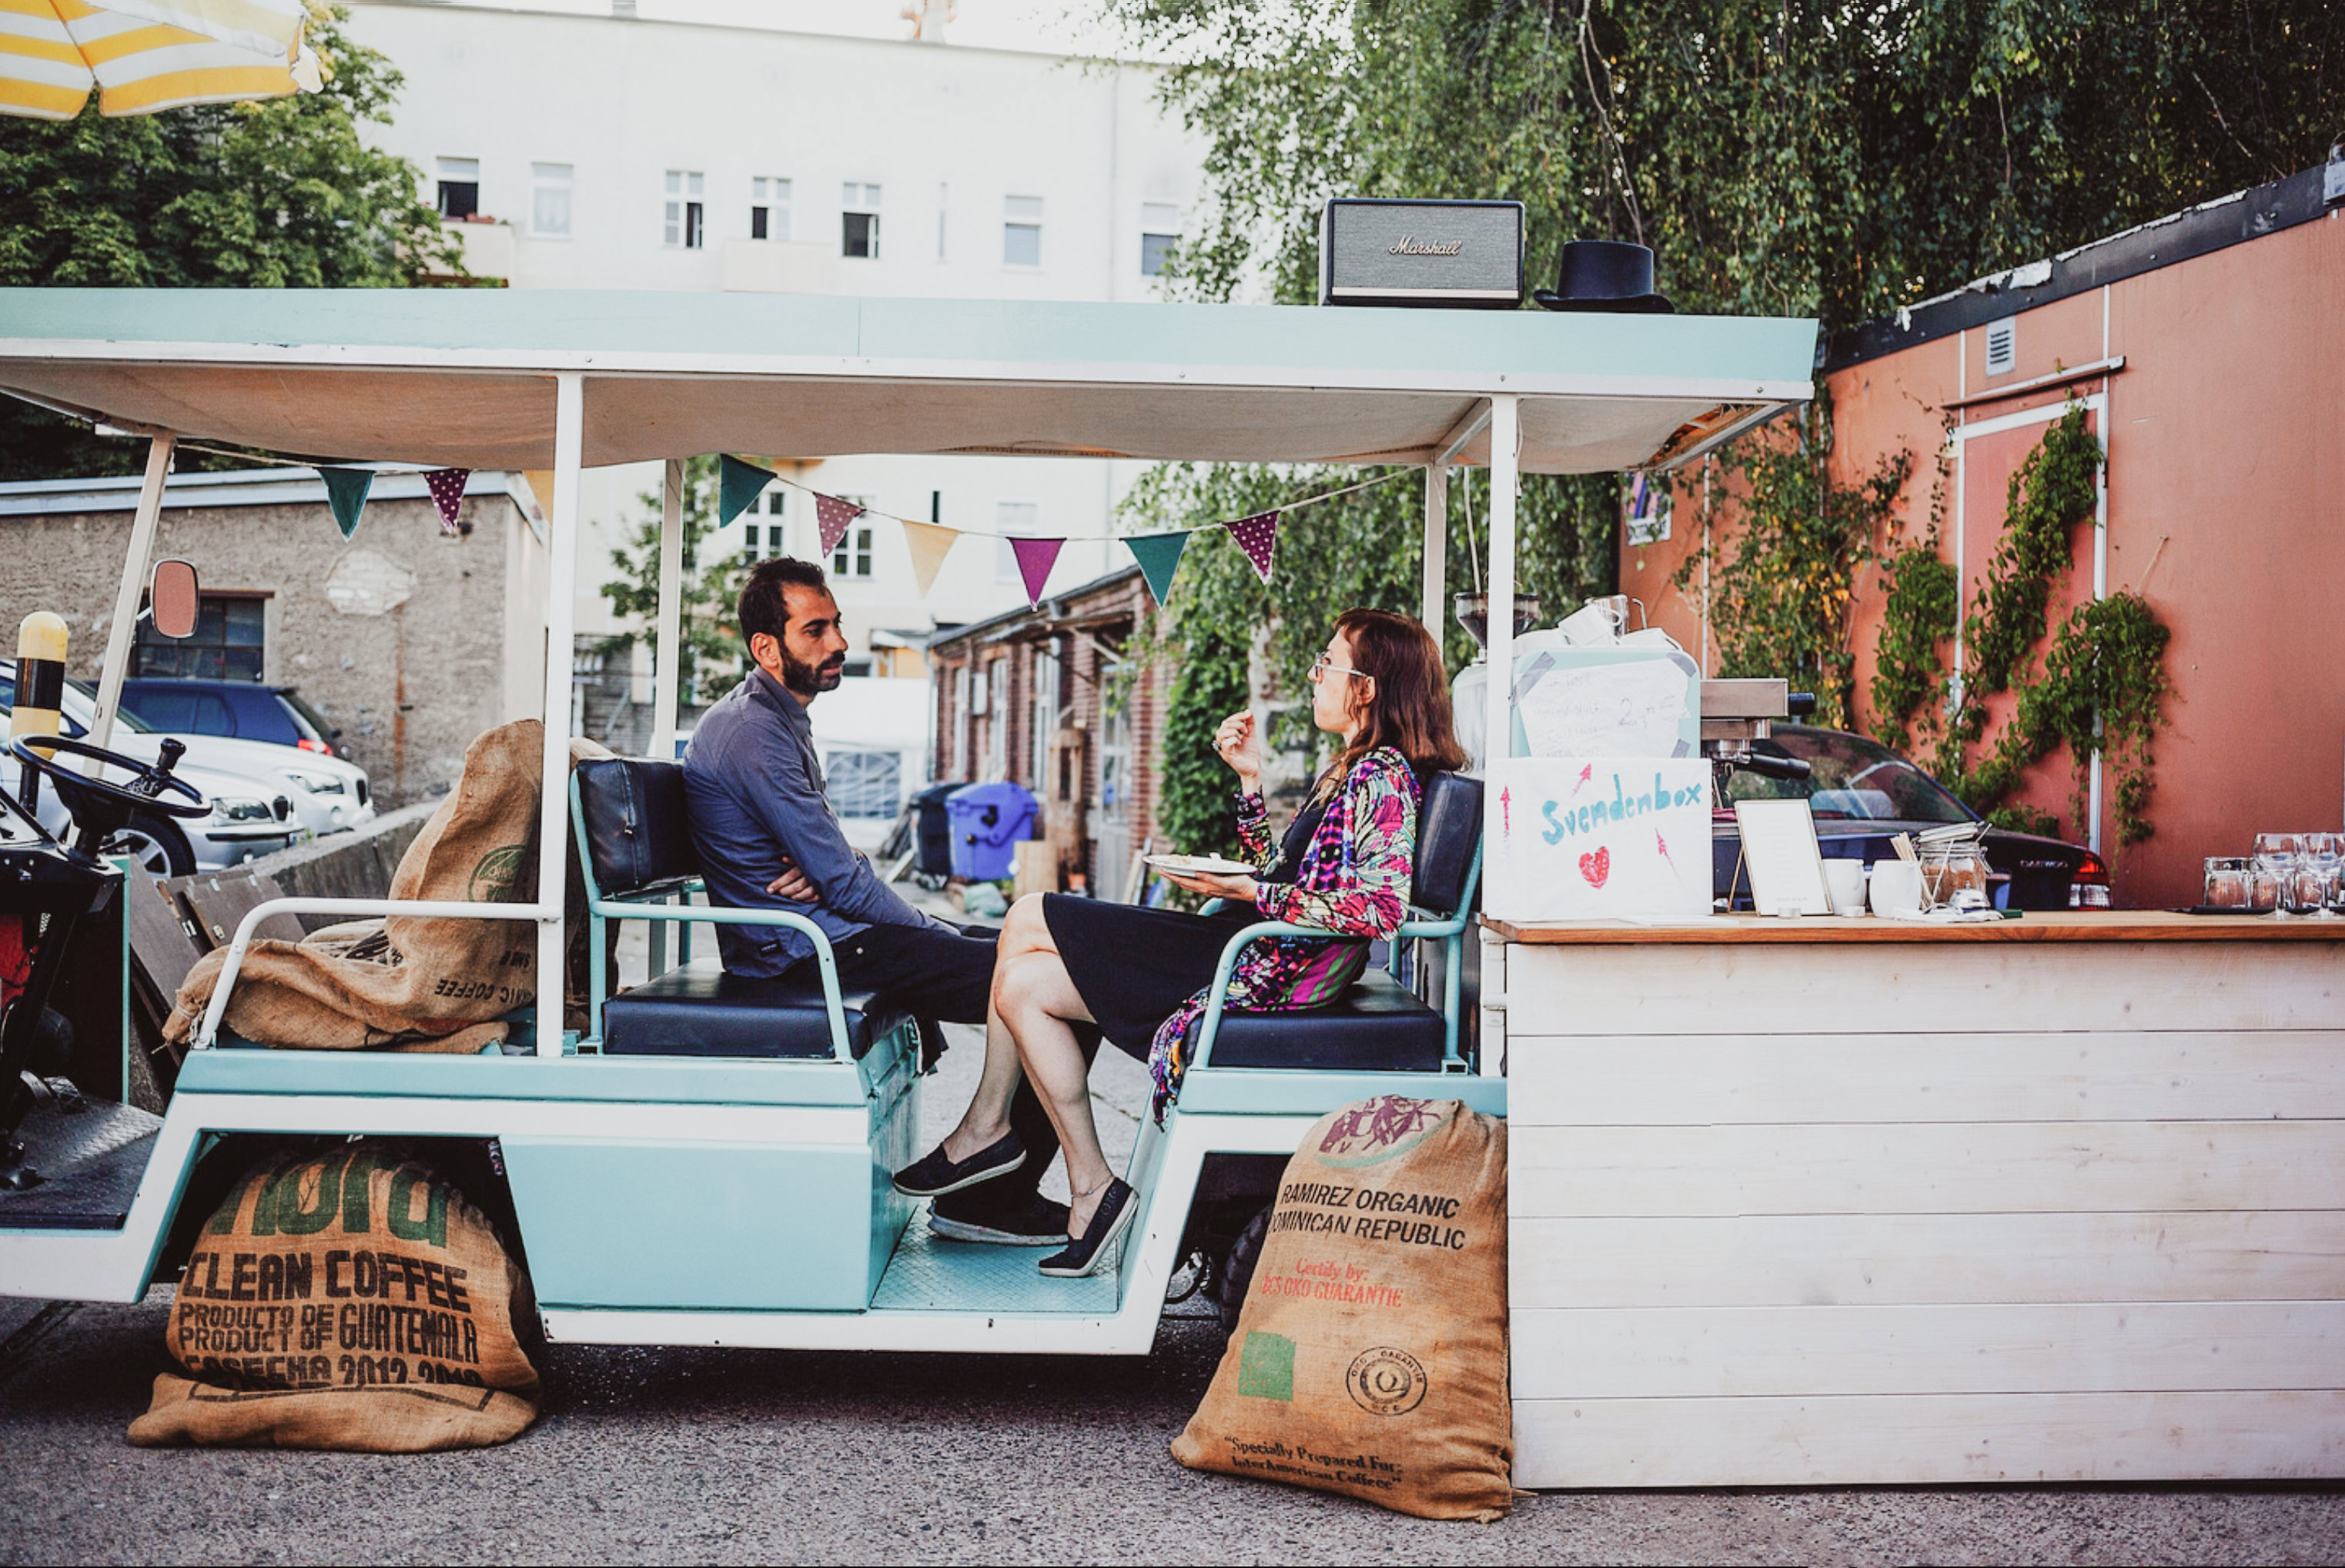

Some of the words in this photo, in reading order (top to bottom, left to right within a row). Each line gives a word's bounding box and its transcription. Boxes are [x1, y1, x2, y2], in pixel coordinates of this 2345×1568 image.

[1388, 233, 1462, 256] Marshall
[1542, 772, 1702, 845] Svendenbox
[434, 978, 495, 1000] COFFEE
[1281, 1183, 1353, 1207] RAMIREZ
[1355, 1189, 1460, 1219] ORGANIC
[1354, 1217, 1466, 1250] REPUBLIC
[182, 1250, 312, 1301] CLEAN
[324, 1249, 472, 1313] COFFEE
[179, 1302, 294, 1330] PRODUCTO
[301, 1303, 334, 1327] DE
[178, 1326, 293, 1352] PRODUCT
[300, 1326, 333, 1350] OF
[340, 1303, 479, 1364] GUATEMALA
[1296, 1445, 1367, 1469] Prepared
